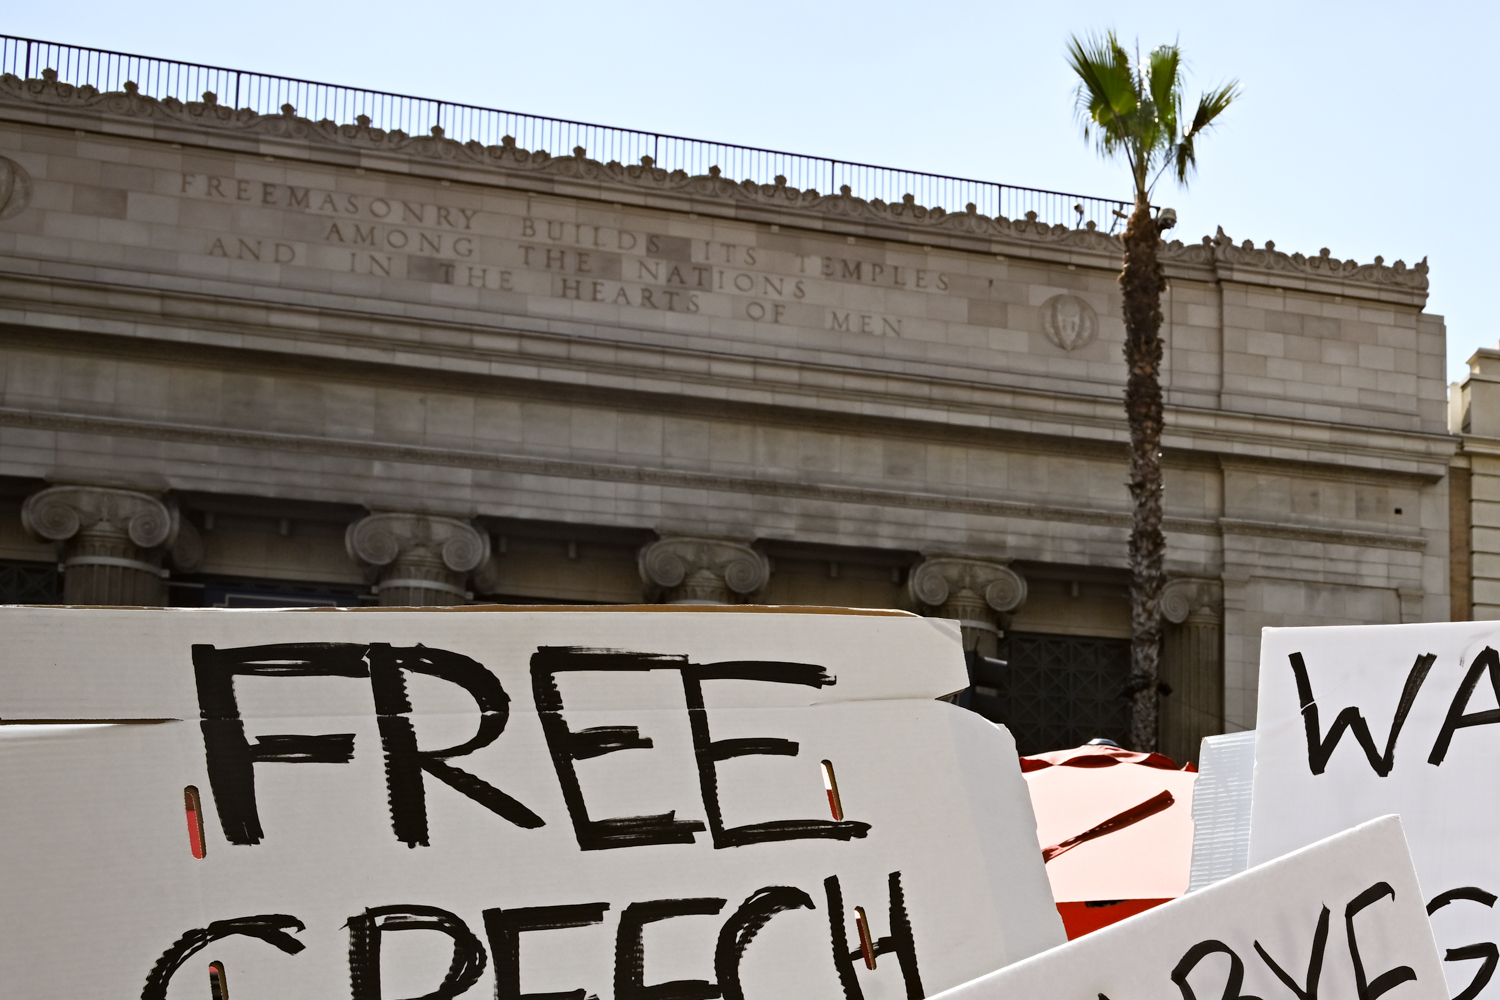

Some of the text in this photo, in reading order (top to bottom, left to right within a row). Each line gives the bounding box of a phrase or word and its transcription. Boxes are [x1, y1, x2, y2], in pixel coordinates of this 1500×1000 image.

[180, 172, 950, 291] FREEMASONRY BUILDS ITS TEMPLES
[326, 222, 806, 299] AMONG THE NATIONS
[210, 237, 903, 338] AND IN THE HEARTS OF MEN
[190, 641, 873, 852] FREE
